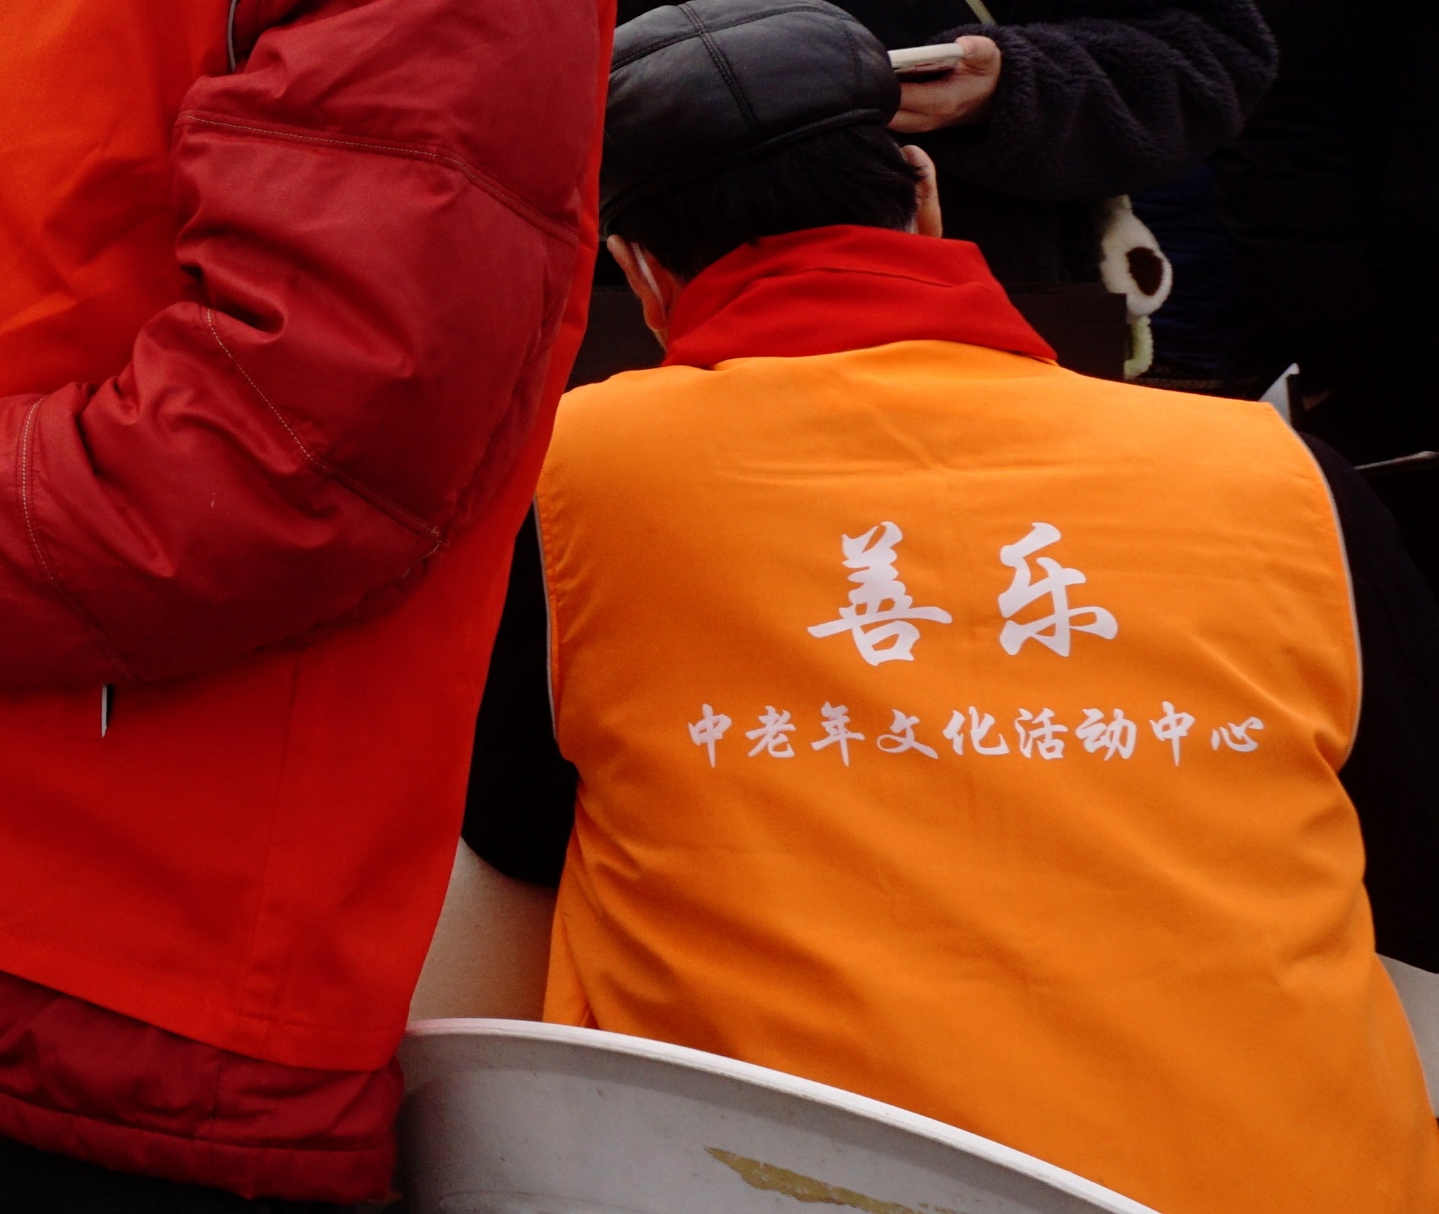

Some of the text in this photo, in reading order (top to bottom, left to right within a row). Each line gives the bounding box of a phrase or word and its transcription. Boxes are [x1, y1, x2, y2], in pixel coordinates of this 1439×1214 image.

[807, 521, 1119, 666] 善乐
[687, 700, 1265, 769] 中老年文化活动中心
